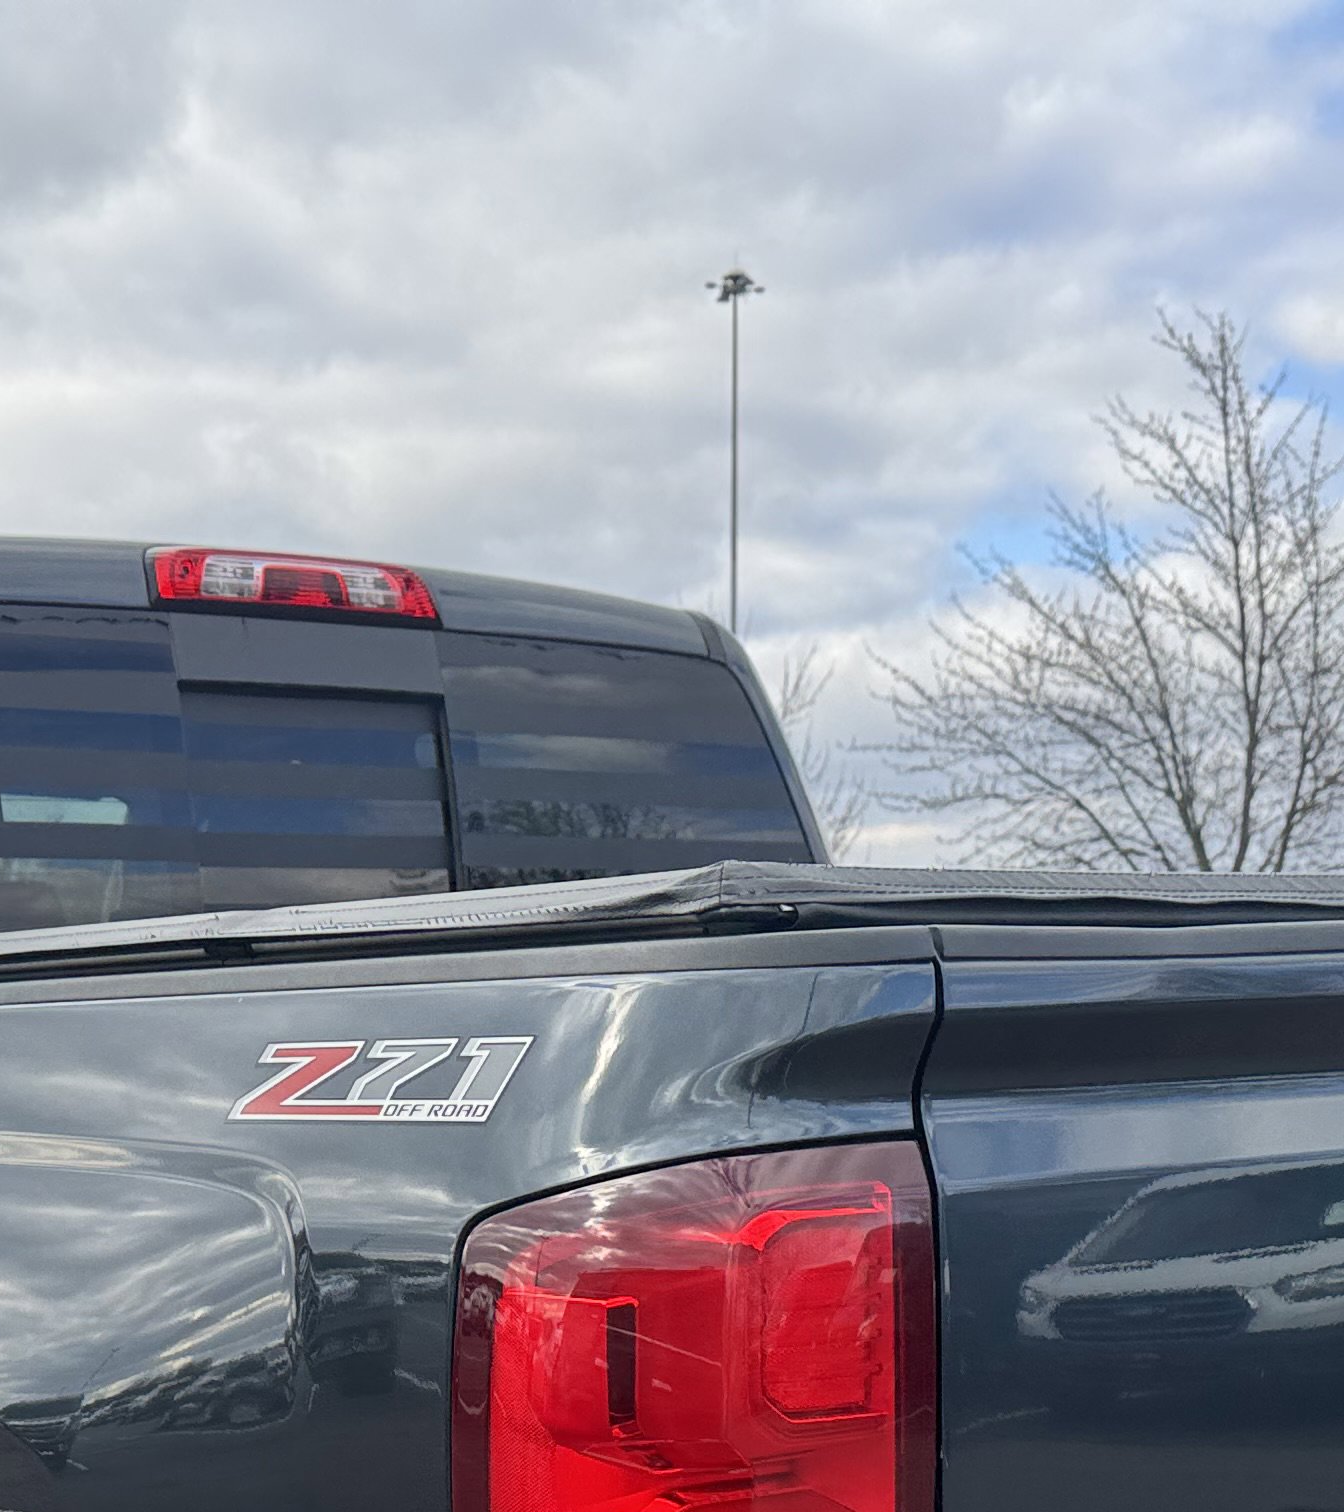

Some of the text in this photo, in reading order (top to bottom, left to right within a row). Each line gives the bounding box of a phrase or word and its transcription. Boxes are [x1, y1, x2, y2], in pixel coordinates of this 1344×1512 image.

[226, 1036, 536, 1122] Z71
[383, 1103, 491, 1118] OFF ROAD
